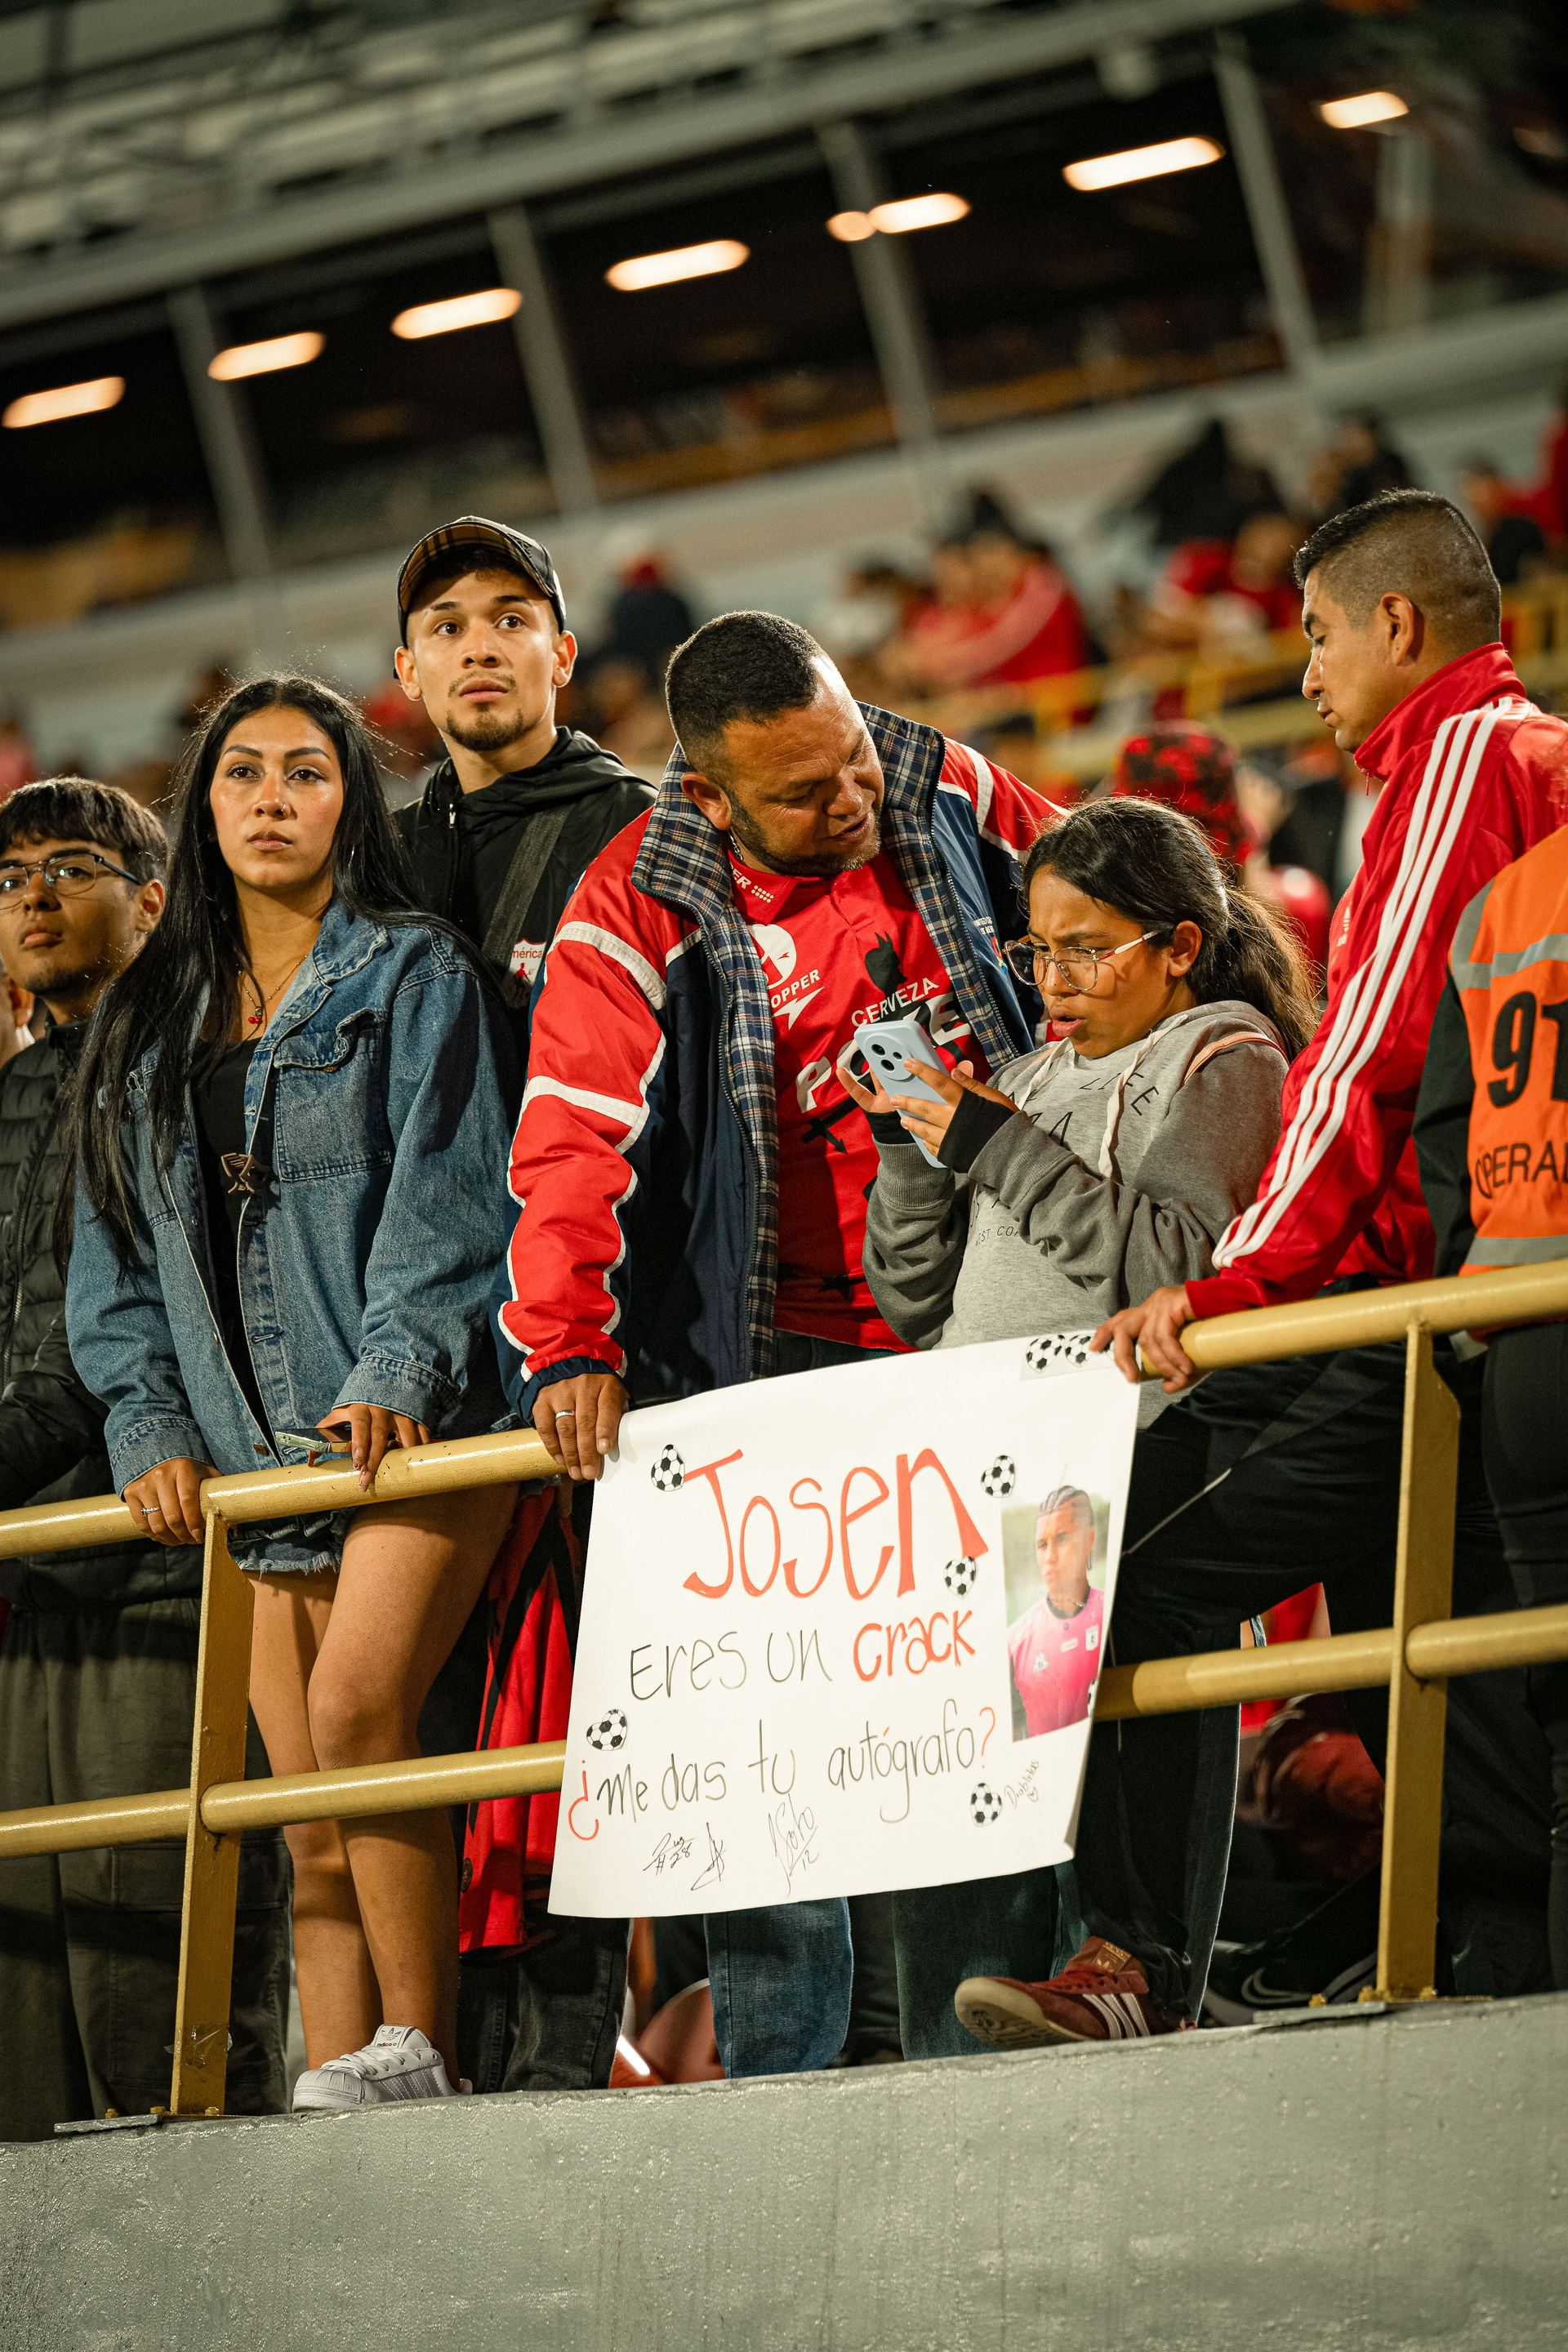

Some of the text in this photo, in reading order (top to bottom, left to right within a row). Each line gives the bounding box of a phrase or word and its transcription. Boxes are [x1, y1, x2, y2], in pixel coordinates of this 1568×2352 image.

[728, 862, 751, 889] ER
[851, 977, 940, 1027] CERVEZA
[1487, 991, 1568, 1109] 91
[683, 1448, 989, 1599] Josen
[630, 1631, 747, 1700] Eres
[662, 1753, 727, 1811] das
[748, 1718, 795, 1795] tu
[827, 1698, 996, 1824] autógrafo?
